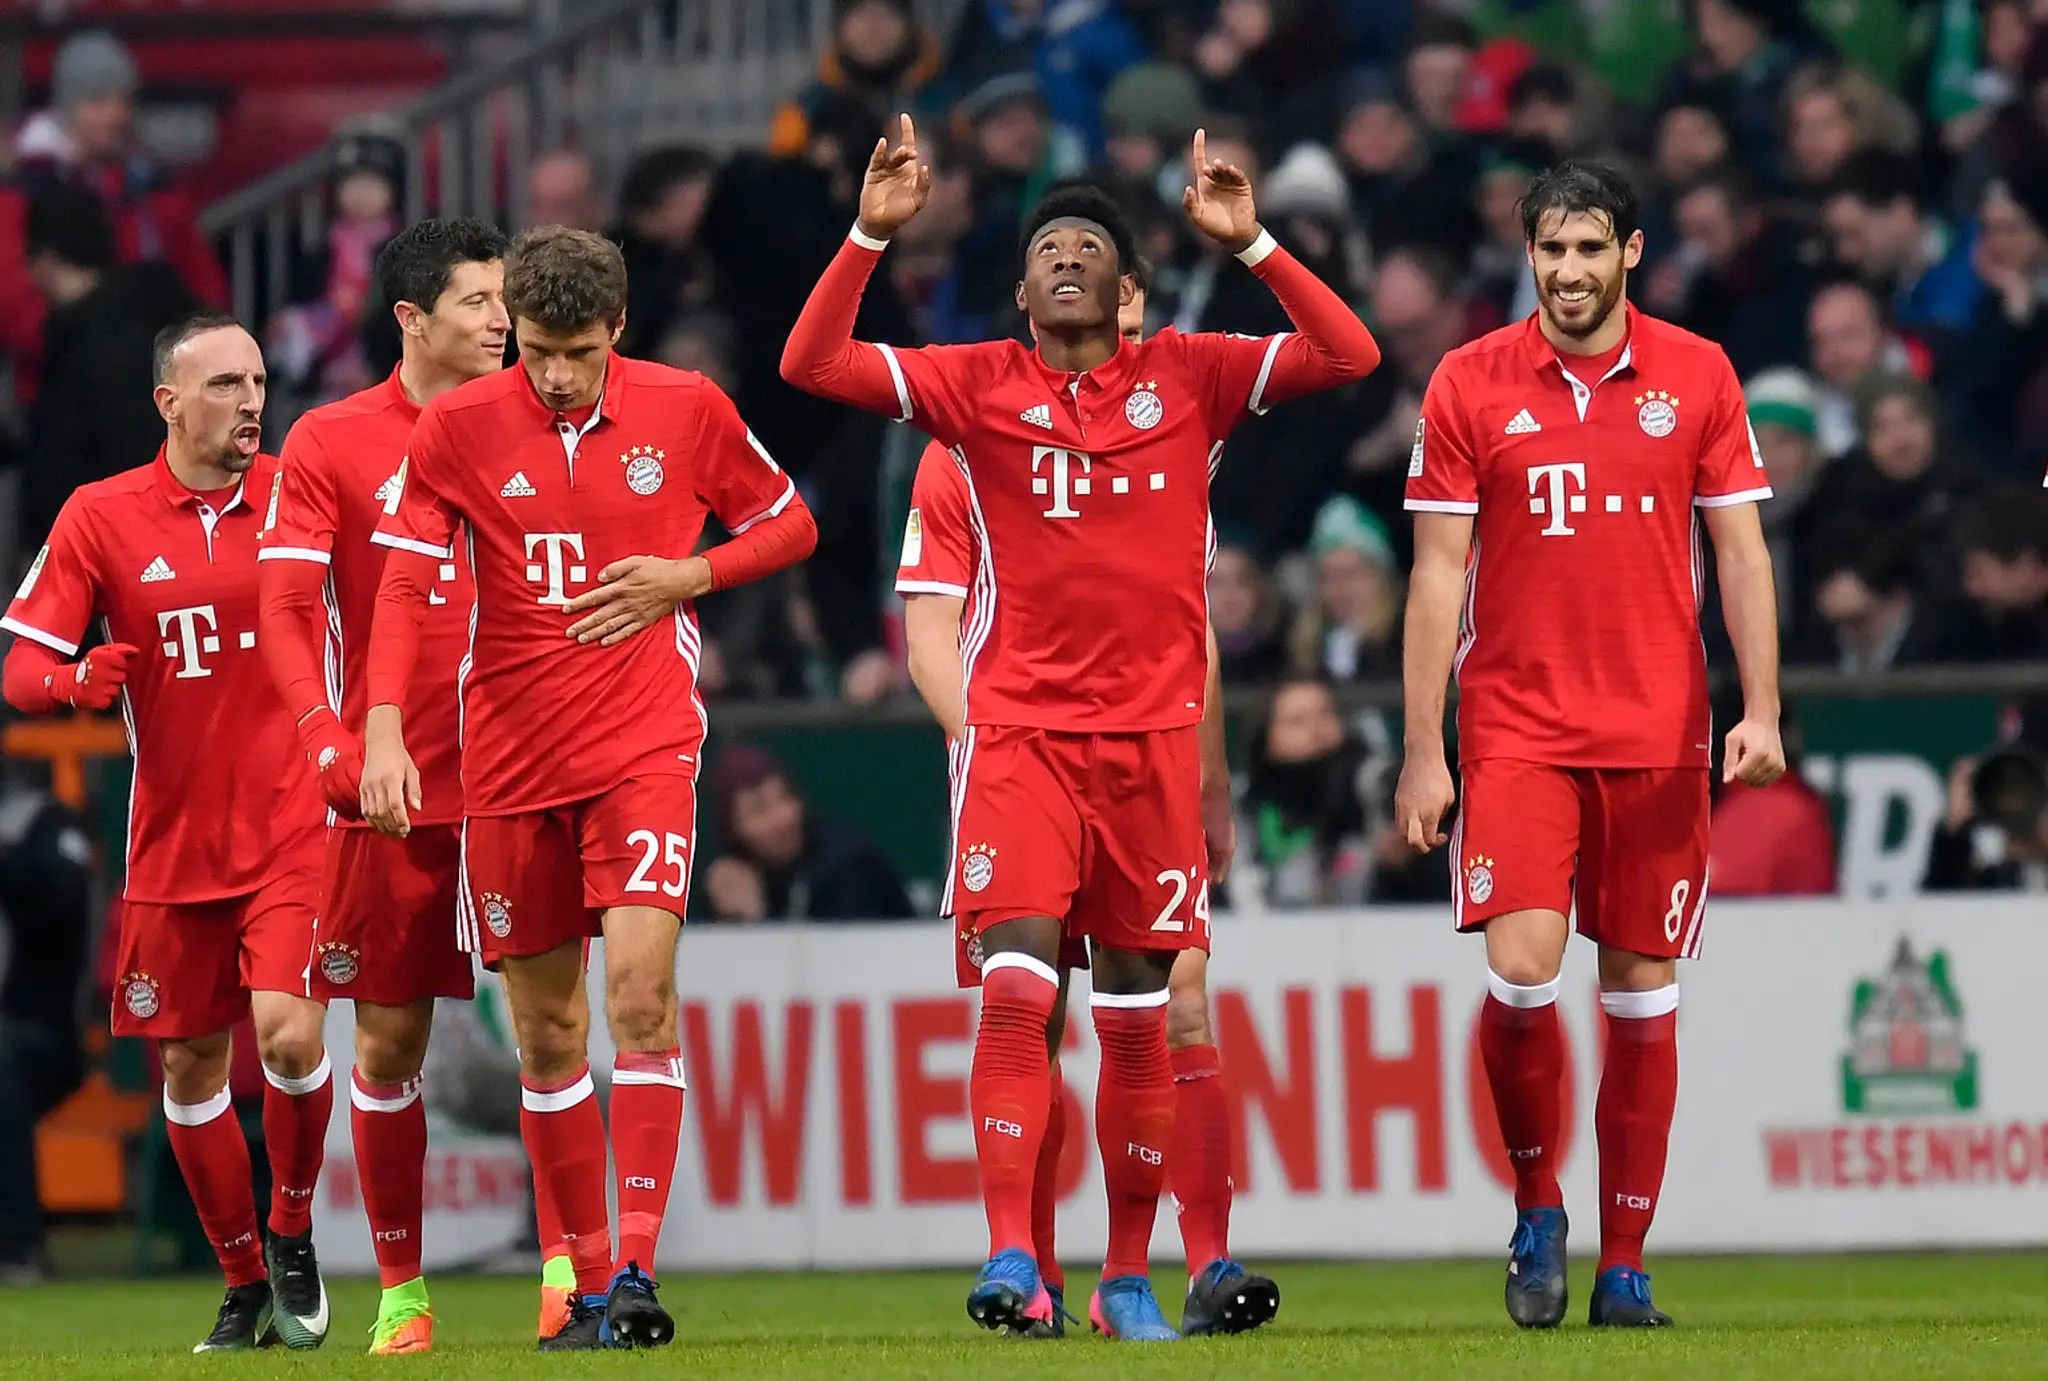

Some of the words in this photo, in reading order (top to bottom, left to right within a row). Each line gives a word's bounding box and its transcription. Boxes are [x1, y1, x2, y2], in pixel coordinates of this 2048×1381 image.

[624, 829, 687, 898] 25
[1664, 879, 1690, 943] 8
[683, 982, 1604, 1207] WIENHO
[984, 1116, 1022, 1138] FCB
[1128, 1142, 1162, 1165] FCB
[1763, 1121, 2048, 1189] WIESENHO
[625, 1176, 656, 1189] FCB
[1616, 1193, 1650, 1210] FCB
[376, 1229, 407, 1242] FCB
